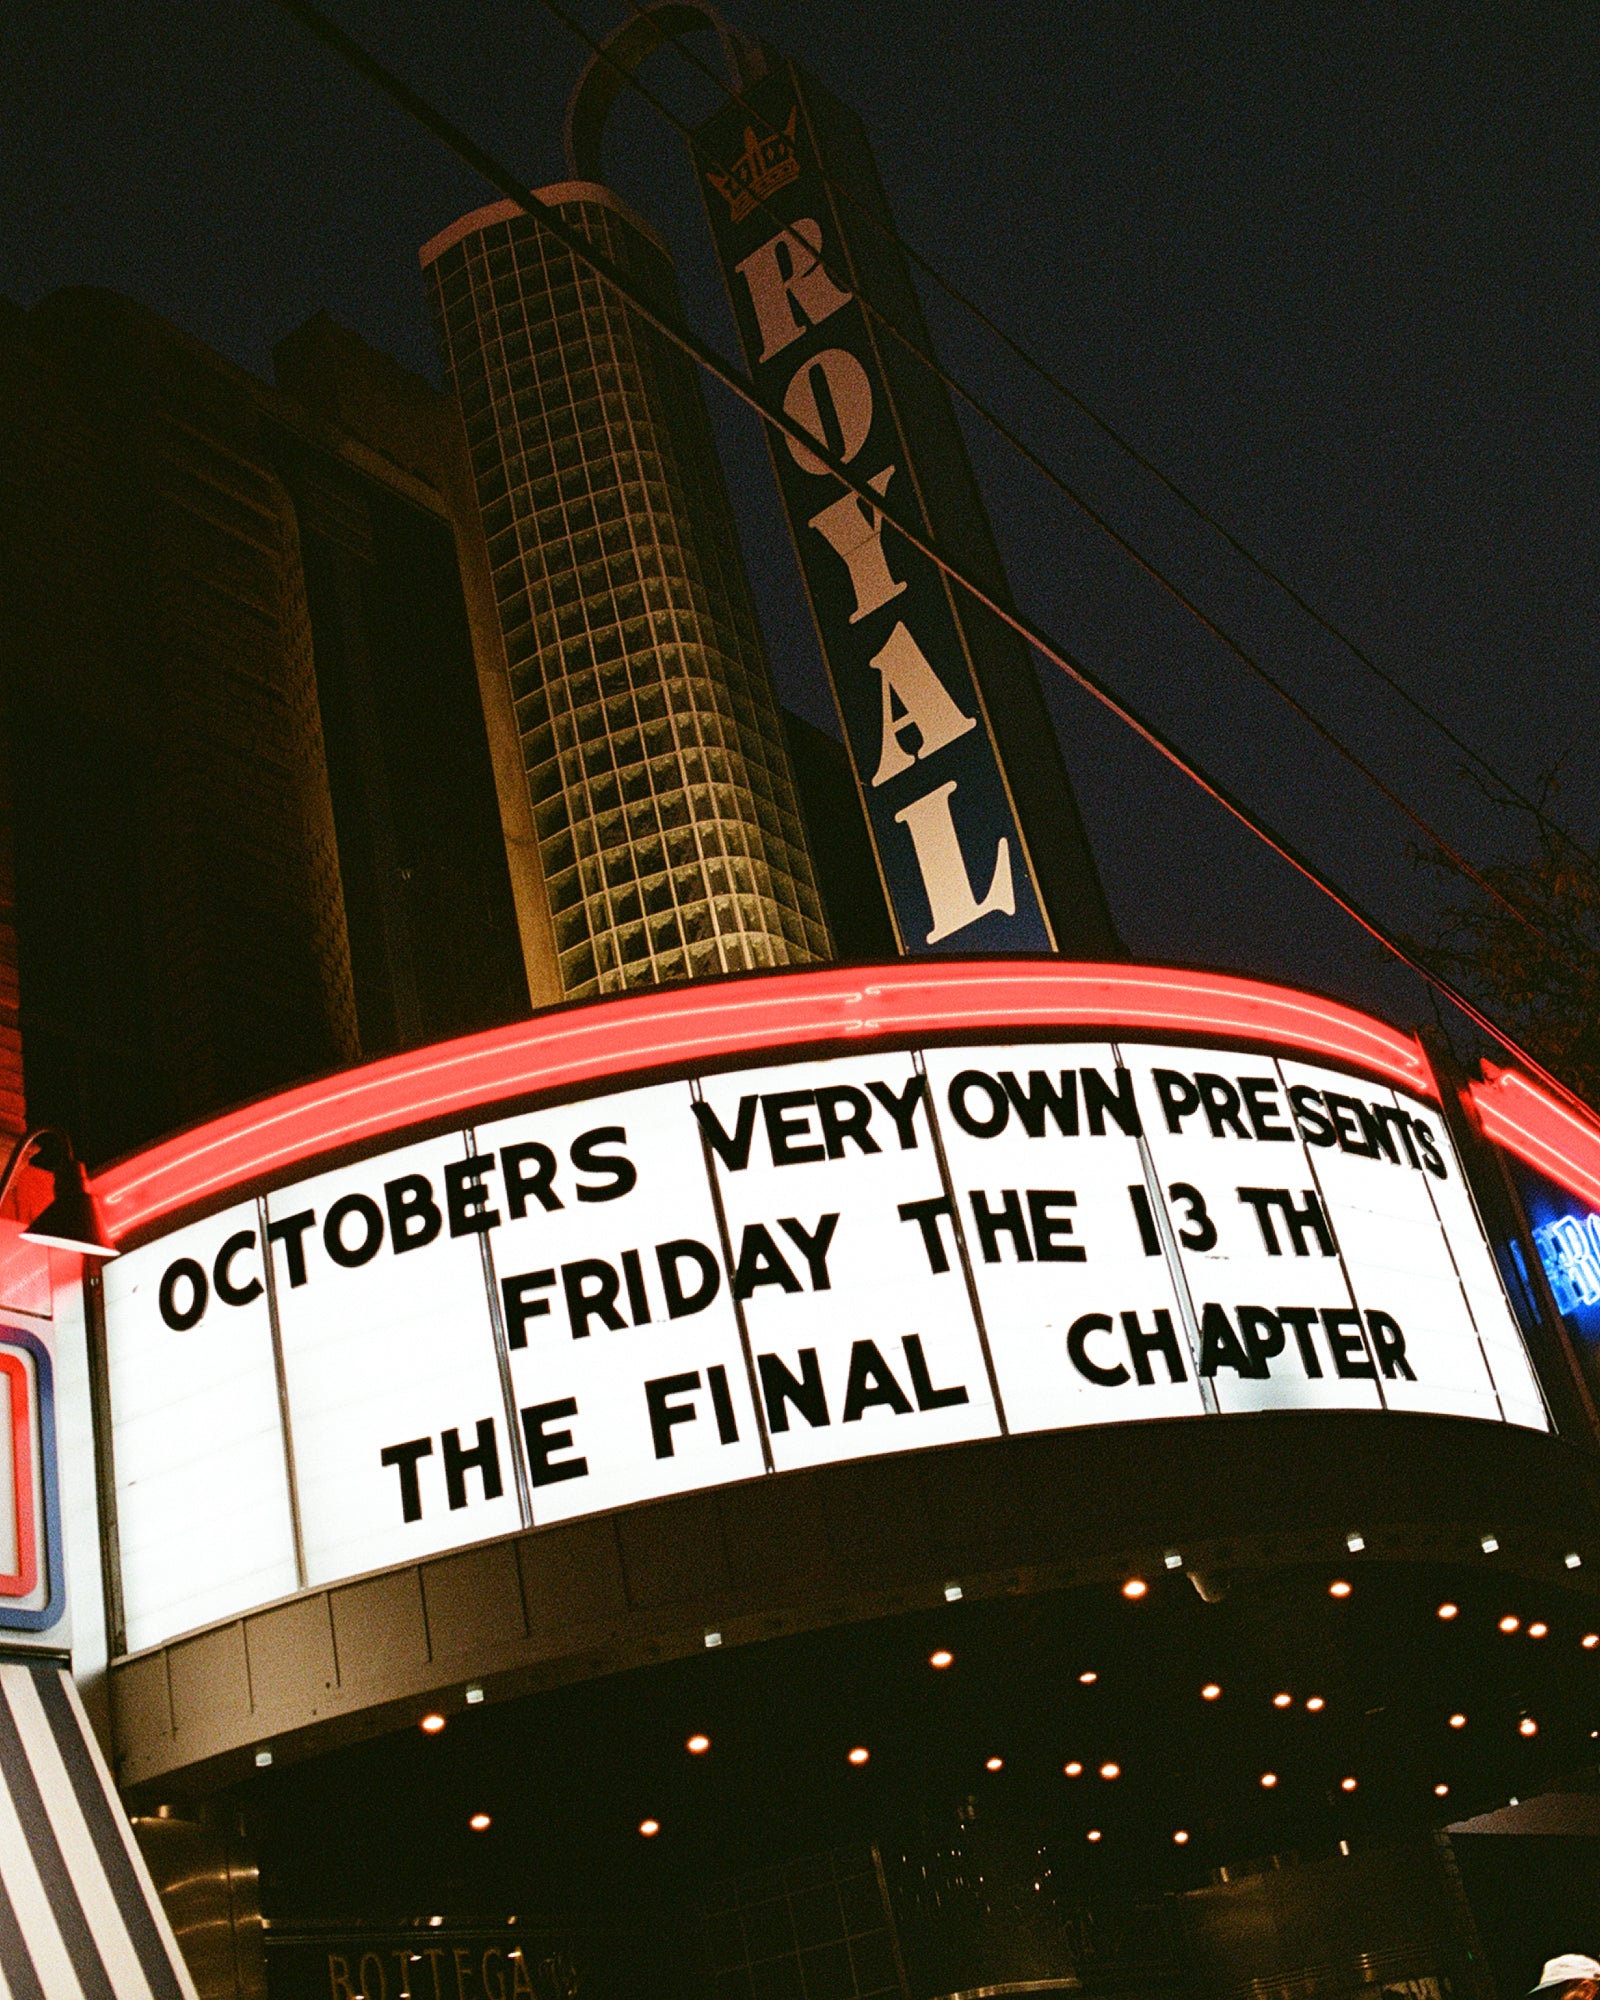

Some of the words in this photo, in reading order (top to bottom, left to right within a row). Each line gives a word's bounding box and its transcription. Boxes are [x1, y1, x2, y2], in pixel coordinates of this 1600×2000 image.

[735, 217, 1017, 945] ROYAL
[160, 1126, 637, 1331] OCTOBERS
[692, 1076, 926, 1172] VERY
[948, 1068, 1142, 1140] OWN
[1152, 1068, 1447, 1180] PRESENTS
[500, 1213, 839, 1352] FRIDAY
[899, 1190, 1087, 1275] THE
[1128, 1183, 1218, 1257] 13
[1237, 1187, 1337, 1258] TH
[381, 1397, 588, 1525] THE
[645, 1334, 969, 1459] FINAL
[1066, 1302, 1417, 1386] CHAPTER
[327, 1946, 537, 2000] BOTTEGA
